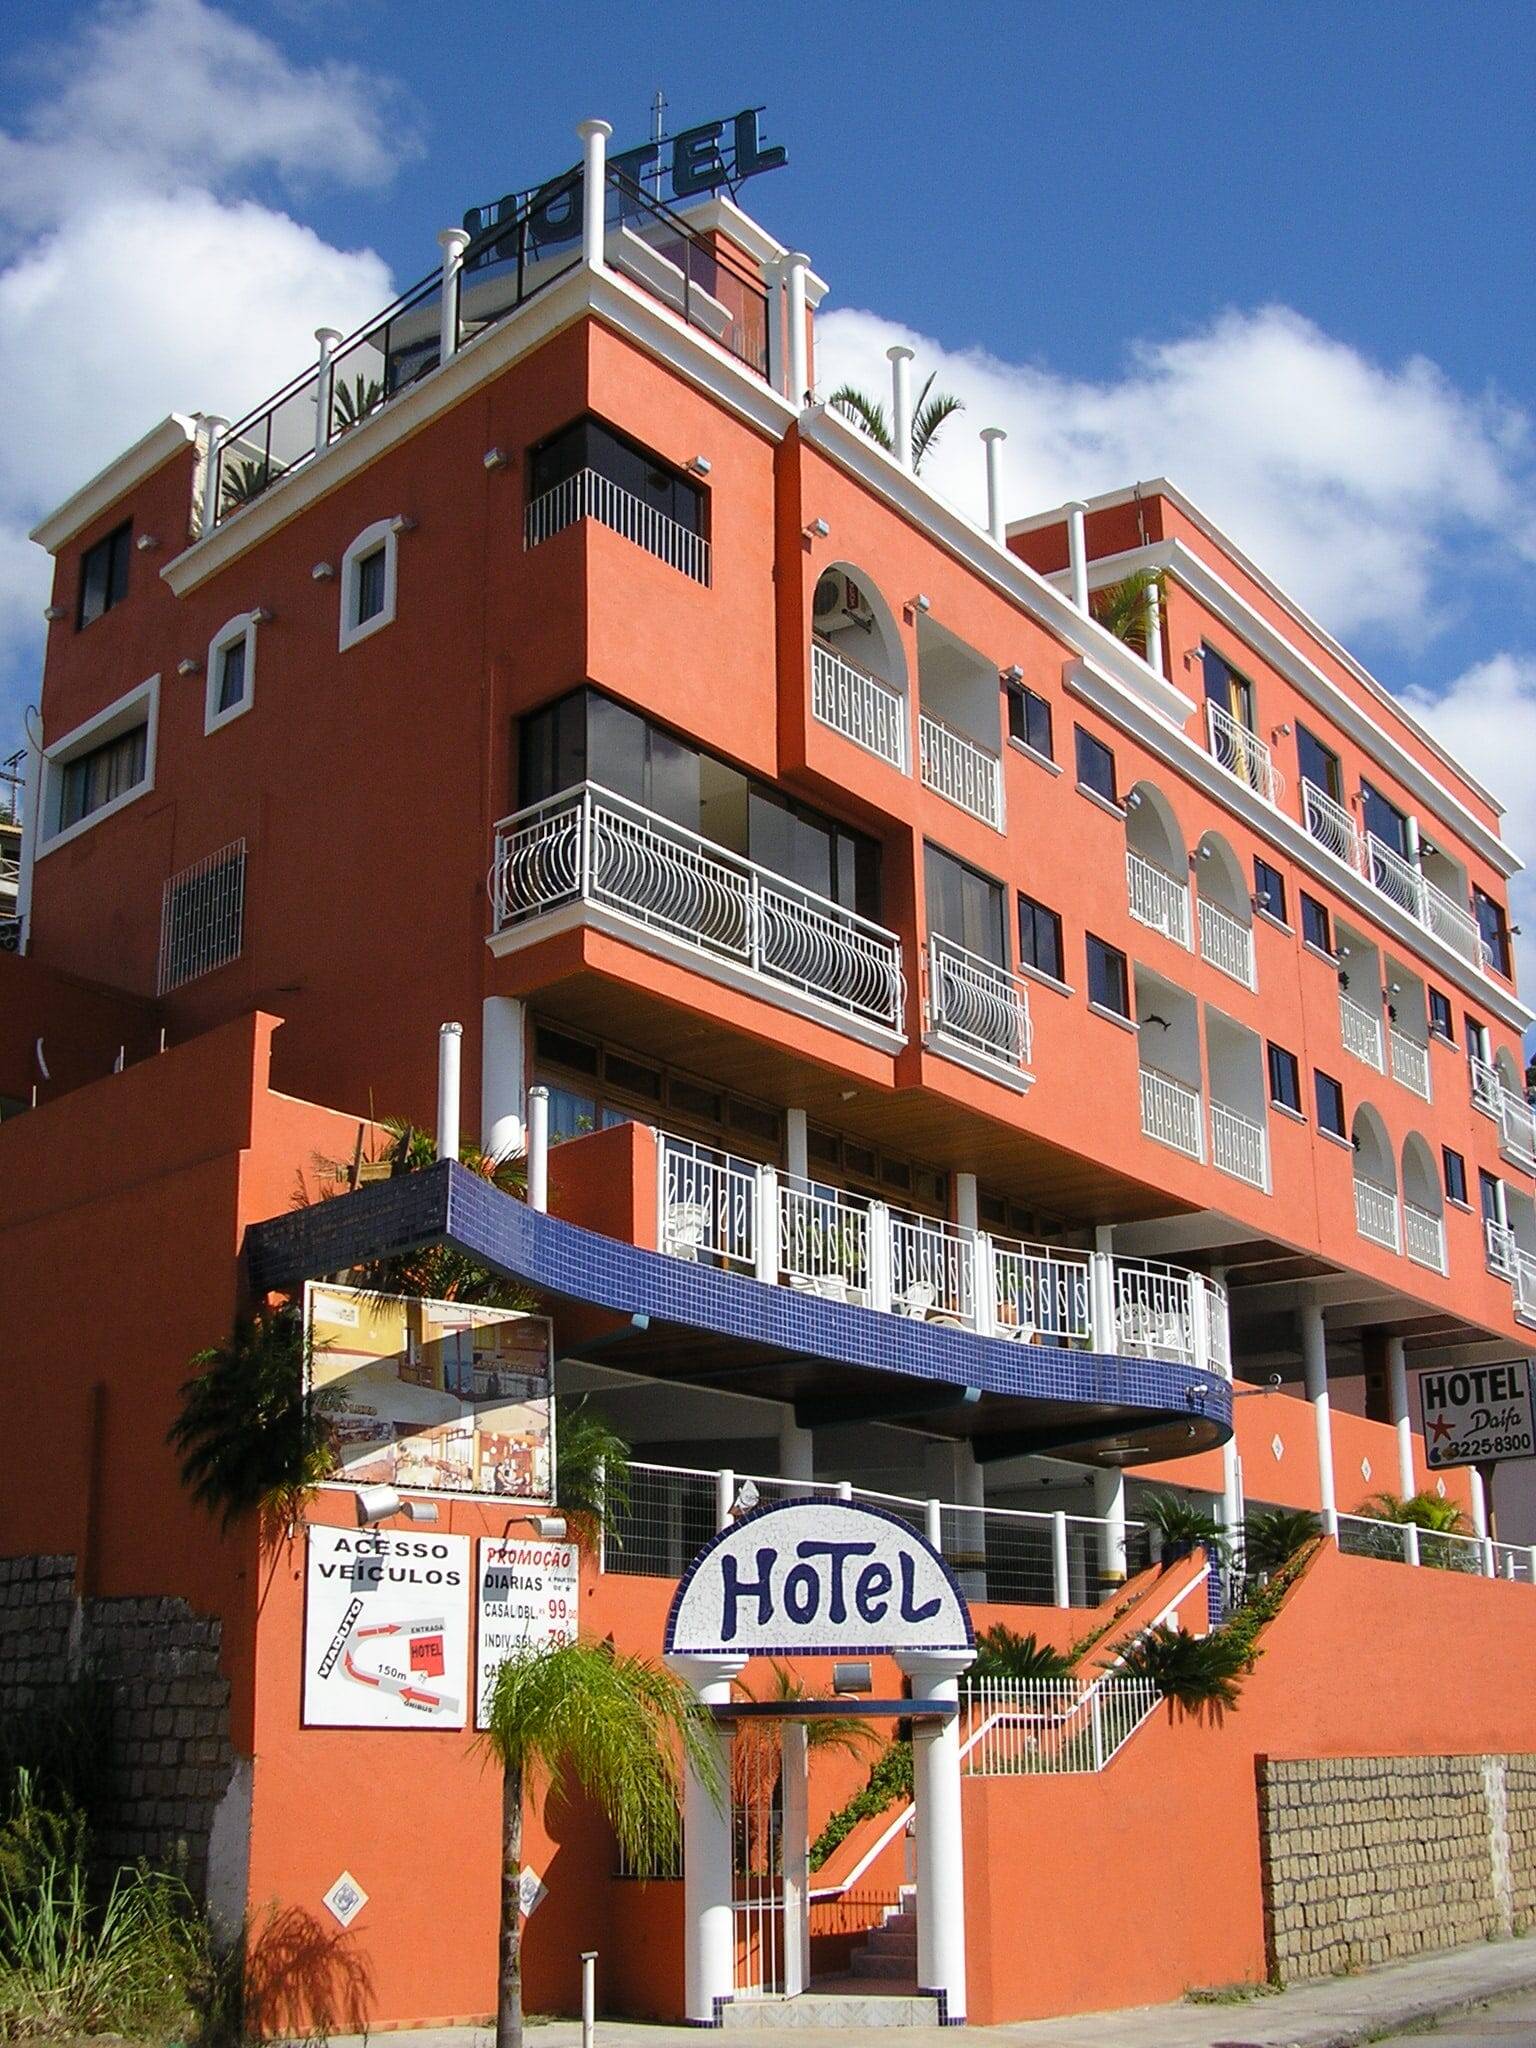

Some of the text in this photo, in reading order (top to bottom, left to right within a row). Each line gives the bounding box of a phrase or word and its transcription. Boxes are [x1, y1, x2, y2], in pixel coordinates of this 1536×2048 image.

[1425, 1366, 1524, 1410] HOTEL
[1463, 1406, 1521, 1438] Daifa
[334, 1538, 449, 1559] ACESSO
[318, 1560, 461, 1586] VEÍCULOS
[484, 1574, 543, 1591] DIARIAS
[485, 1603, 515, 1619] CASAL
[318, 1598, 363, 1679] VIADUTO
[411, 1625, 445, 1634] ENTRADA
[412, 1643, 442, 1658] HOTEL
[378, 1664, 407, 1681] 150m
